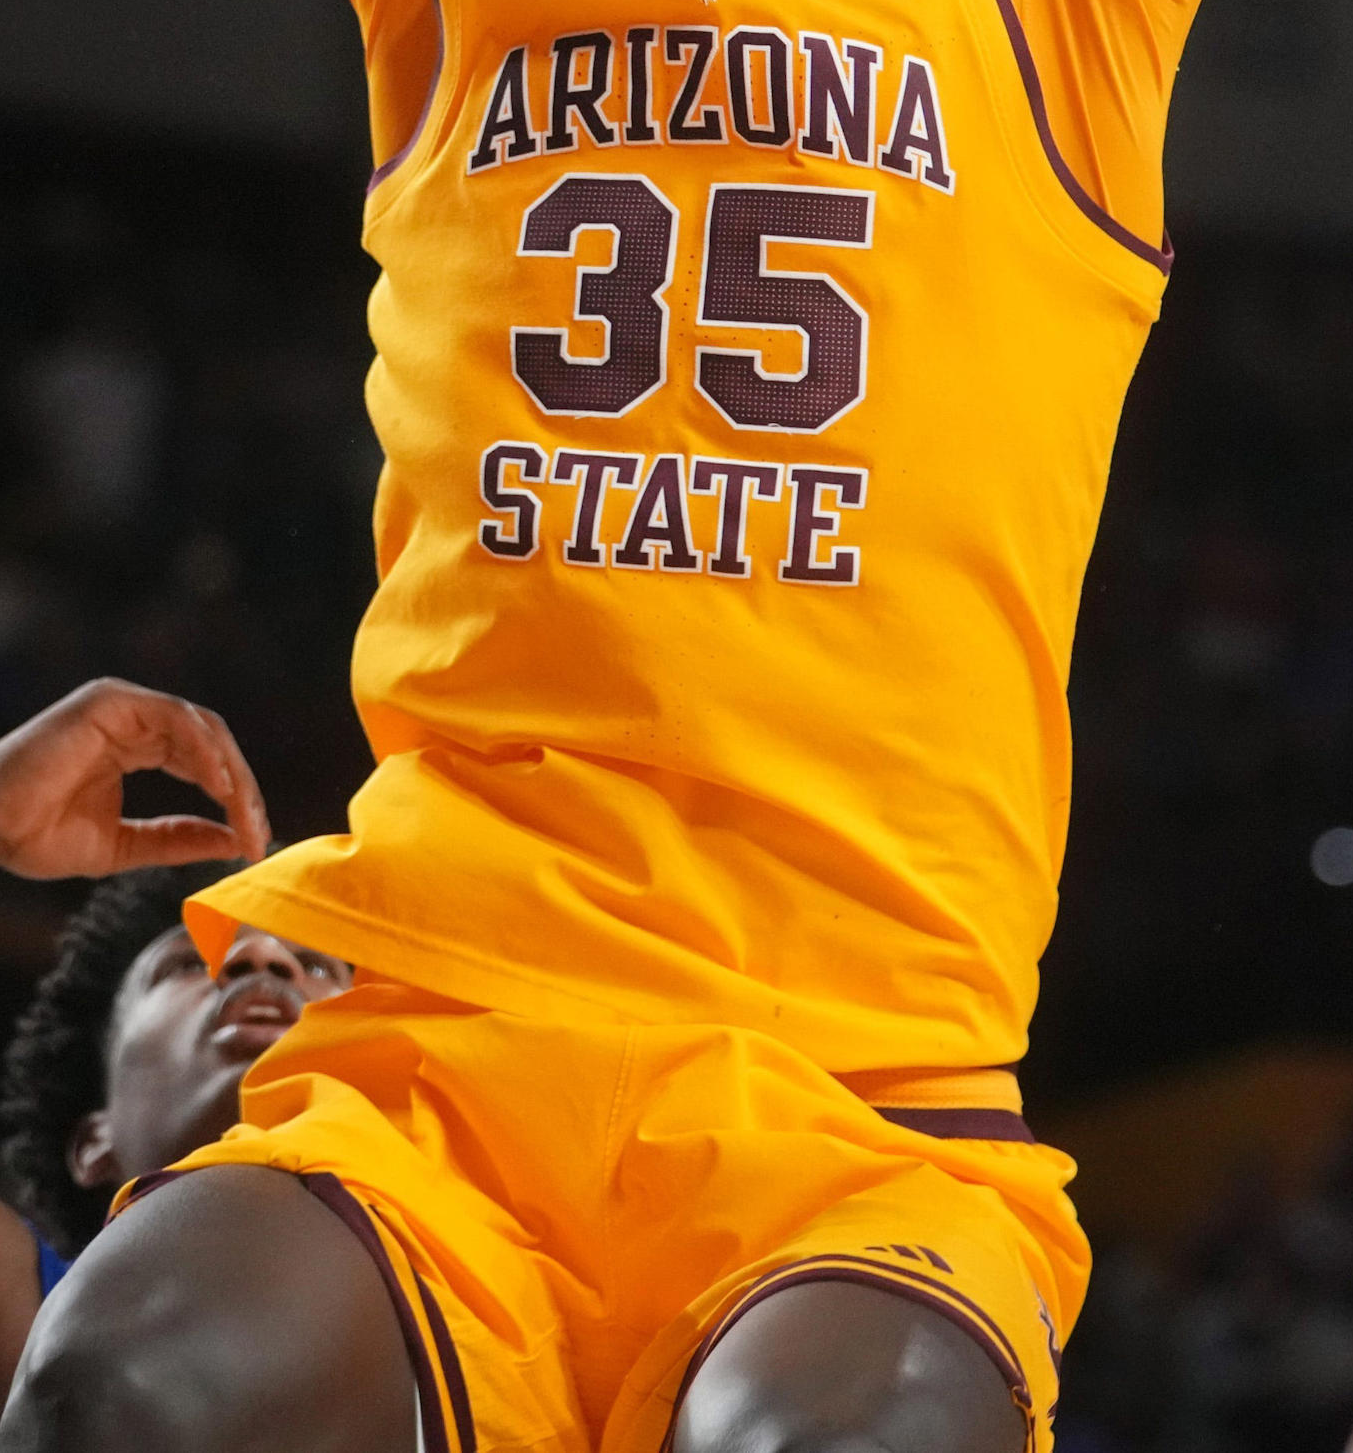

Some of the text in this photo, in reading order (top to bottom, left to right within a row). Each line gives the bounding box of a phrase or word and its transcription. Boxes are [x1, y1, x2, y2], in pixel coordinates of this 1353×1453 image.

[466, 25, 955, 195] ARIZONA
[510, 173, 876, 434] 35
[478, 441, 869, 587] STATE
